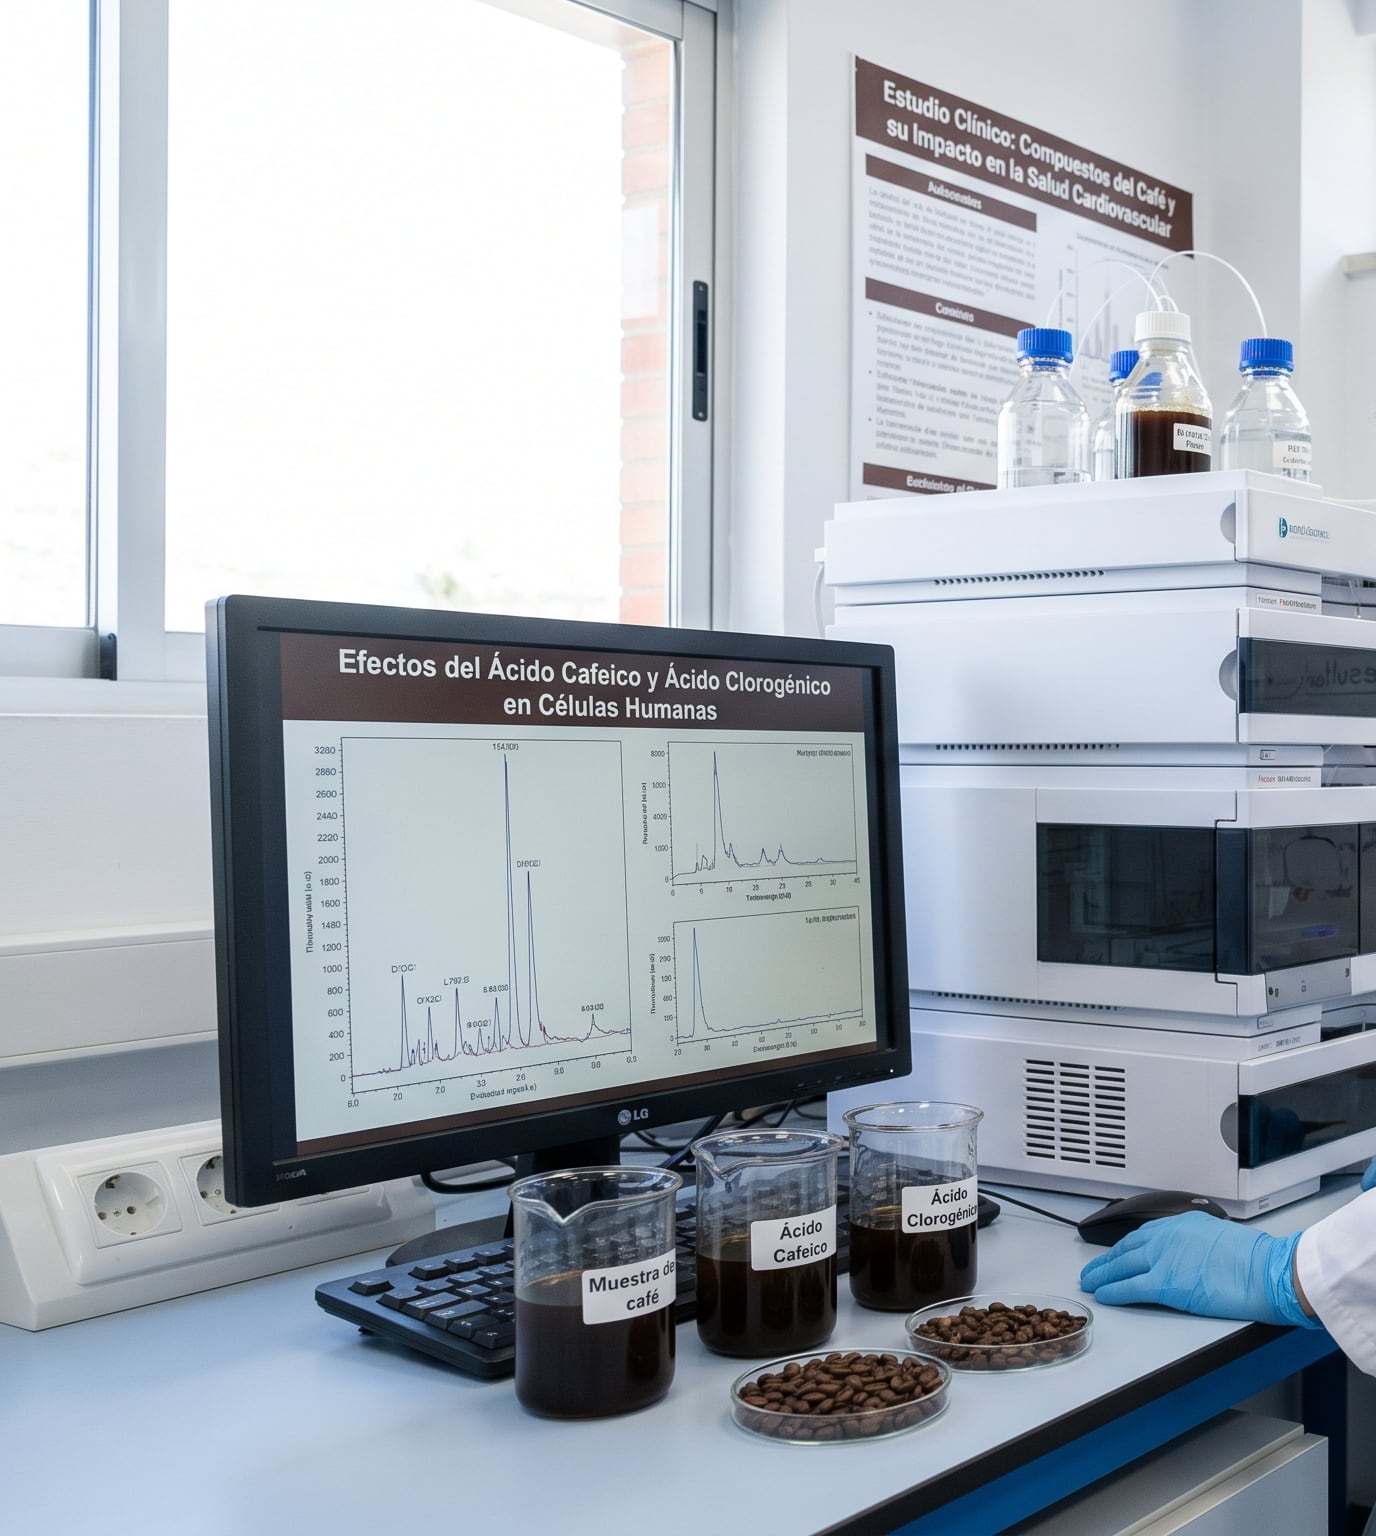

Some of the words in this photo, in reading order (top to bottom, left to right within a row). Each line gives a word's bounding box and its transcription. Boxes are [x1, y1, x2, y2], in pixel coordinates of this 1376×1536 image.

[884, 80, 950, 124] Estudio
[954, 108, 1016, 150] Clínico:
[1019, 133, 1110, 188] Compuestos
[1113, 171, 1134, 198] del
[1137, 181, 1166, 210] Café
[1167, 198, 1176, 217] y
[886, 118, 908, 142] su
[913, 122, 982, 168] Impacto
[985, 155, 1005, 177] en
[1009, 158, 1024, 183] la
[1027, 166, 1069, 200] Salud
[1072, 184, 1172, 238] Cardiovascular
[339, 648, 437, 678] Efectos
[445, 655, 481, 679] del
[488, 652, 555, 683] Ácido
[562, 661, 641, 687] Cafeico
[647, 671, 658, 693] y
[665, 662, 720, 690] Ácido
[726, 671, 831, 698] Clorogénico
[504, 697, 531, 715] en
[538, 693, 619, 718] Células
[626, 697, 718, 720] Humanas
[318, 856, 339, 864] 2000
[320, 878, 340, 886] 1800
[321, 899, 341, 908] 1600
[322, 943, 341, 952] 1200
[322, 965, 342, 973] 1000
[327, 987, 343, 995] 800
[328, 1009, 344, 1017] 600
[328, 1031, 344, 1039] 400
[329, 1053, 345, 1061] 200
[633, 1108, 649, 1120] LG
[931, 1187, 968, 1205] Ácido
[780, 1219, 823, 1240] Ácido
[774, 1242, 828, 1263] Cafeico
[589, 1268, 660, 1293] Muestra
[663, 1260, 675, 1276] de
[626, 1288, 659, 1311] café
